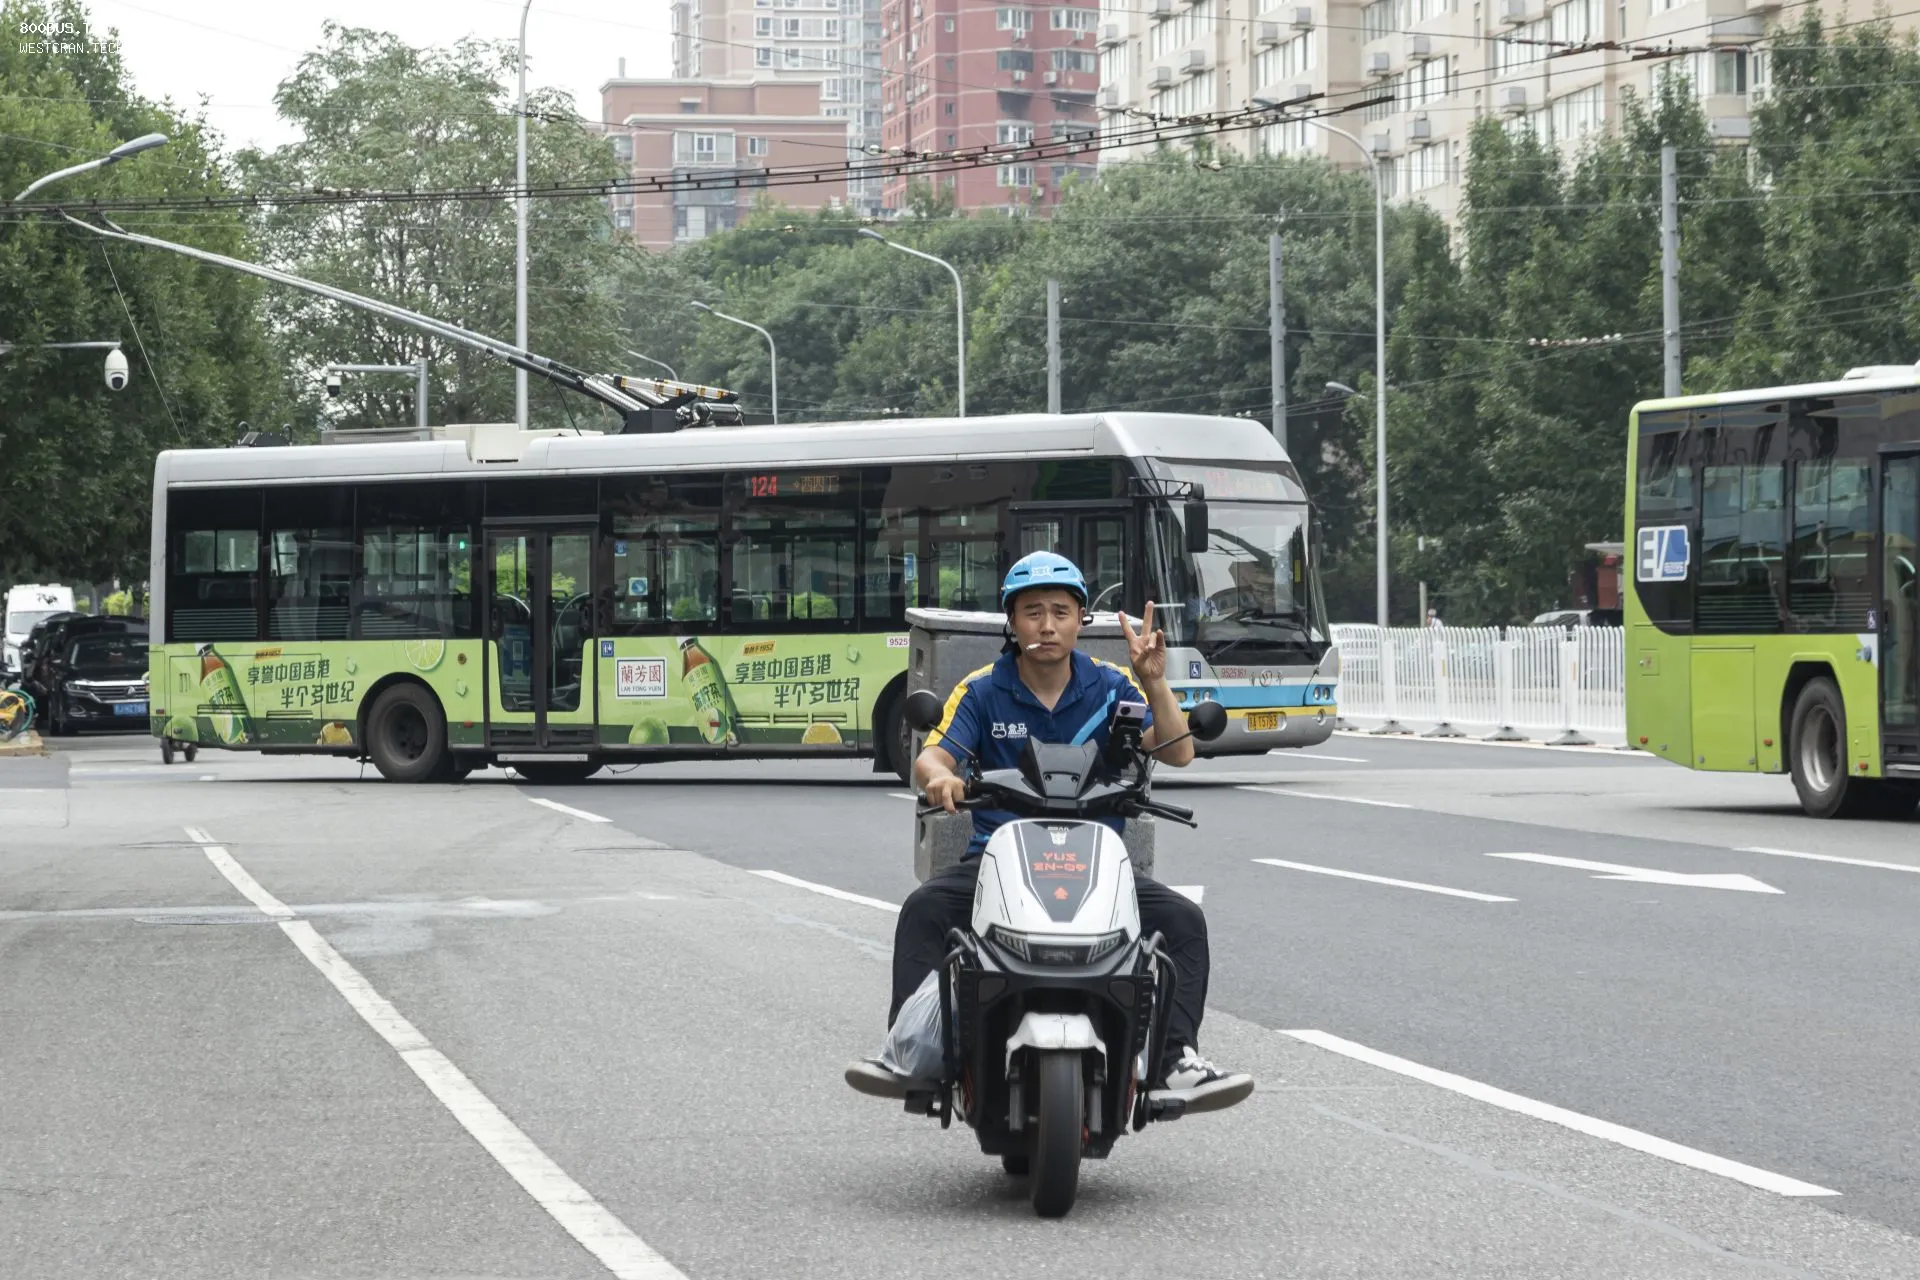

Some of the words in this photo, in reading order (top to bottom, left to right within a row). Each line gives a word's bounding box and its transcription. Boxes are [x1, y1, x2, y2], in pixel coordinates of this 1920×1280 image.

[751, 475, 777, 497] 124
[247, 658, 330, 686] 享誉中国香港
[735, 654, 832, 684] 享誉中国香港
[281, 681, 355, 709] 半个多世纪
[774, 678, 860, 708] 半个多世纪
[1008, 723, 1027, 734] 盒马
